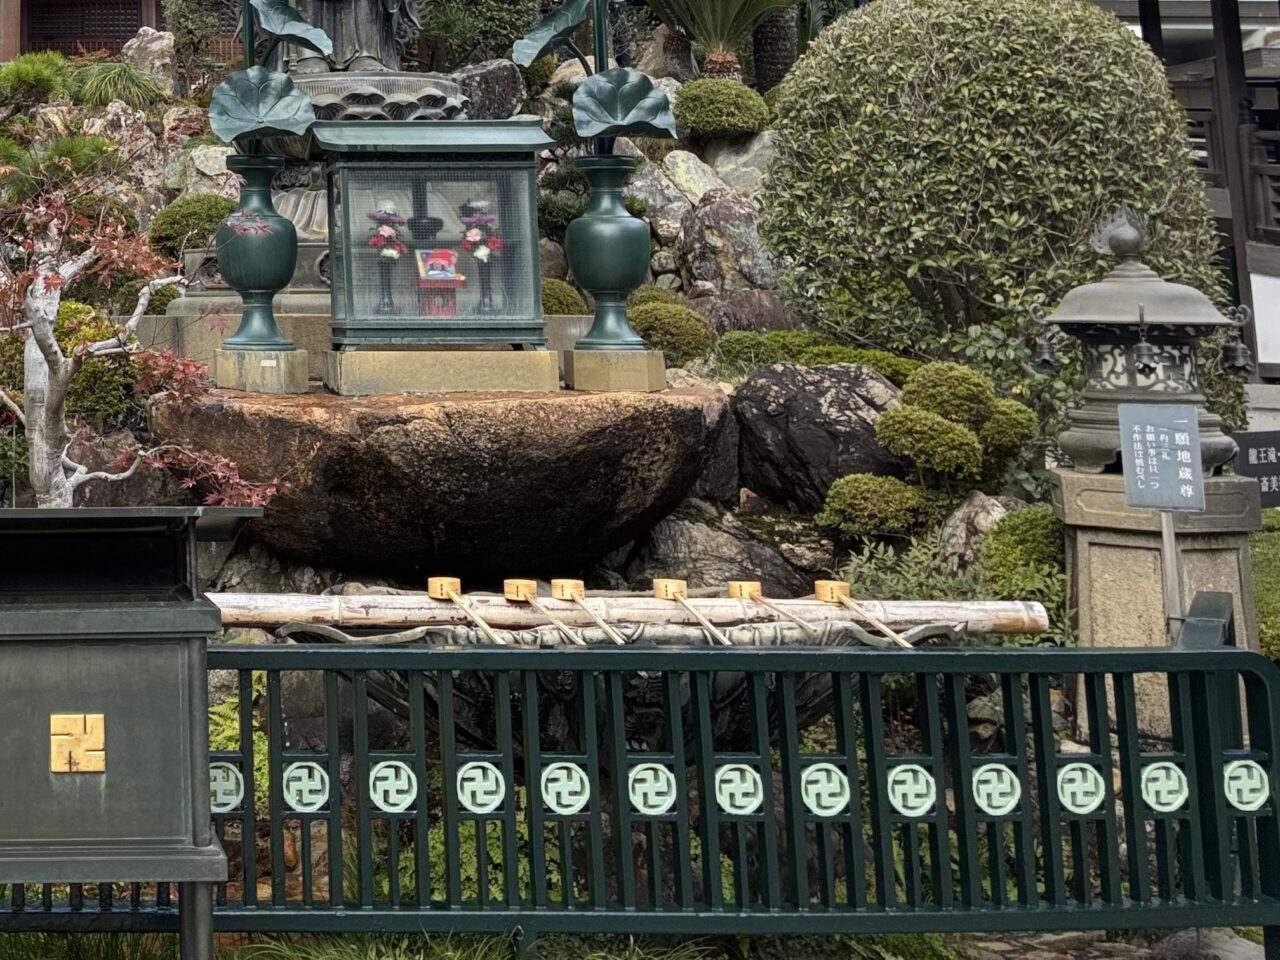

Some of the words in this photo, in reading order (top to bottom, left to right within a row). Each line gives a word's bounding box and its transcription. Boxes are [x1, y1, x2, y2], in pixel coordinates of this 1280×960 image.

[1132, 425, 1145, 489] 不作法は慎むべし
[1145, 425, 1160, 489] お願い事は只一つ
[1173, 419, 1194, 497] 一願地蔵尊
